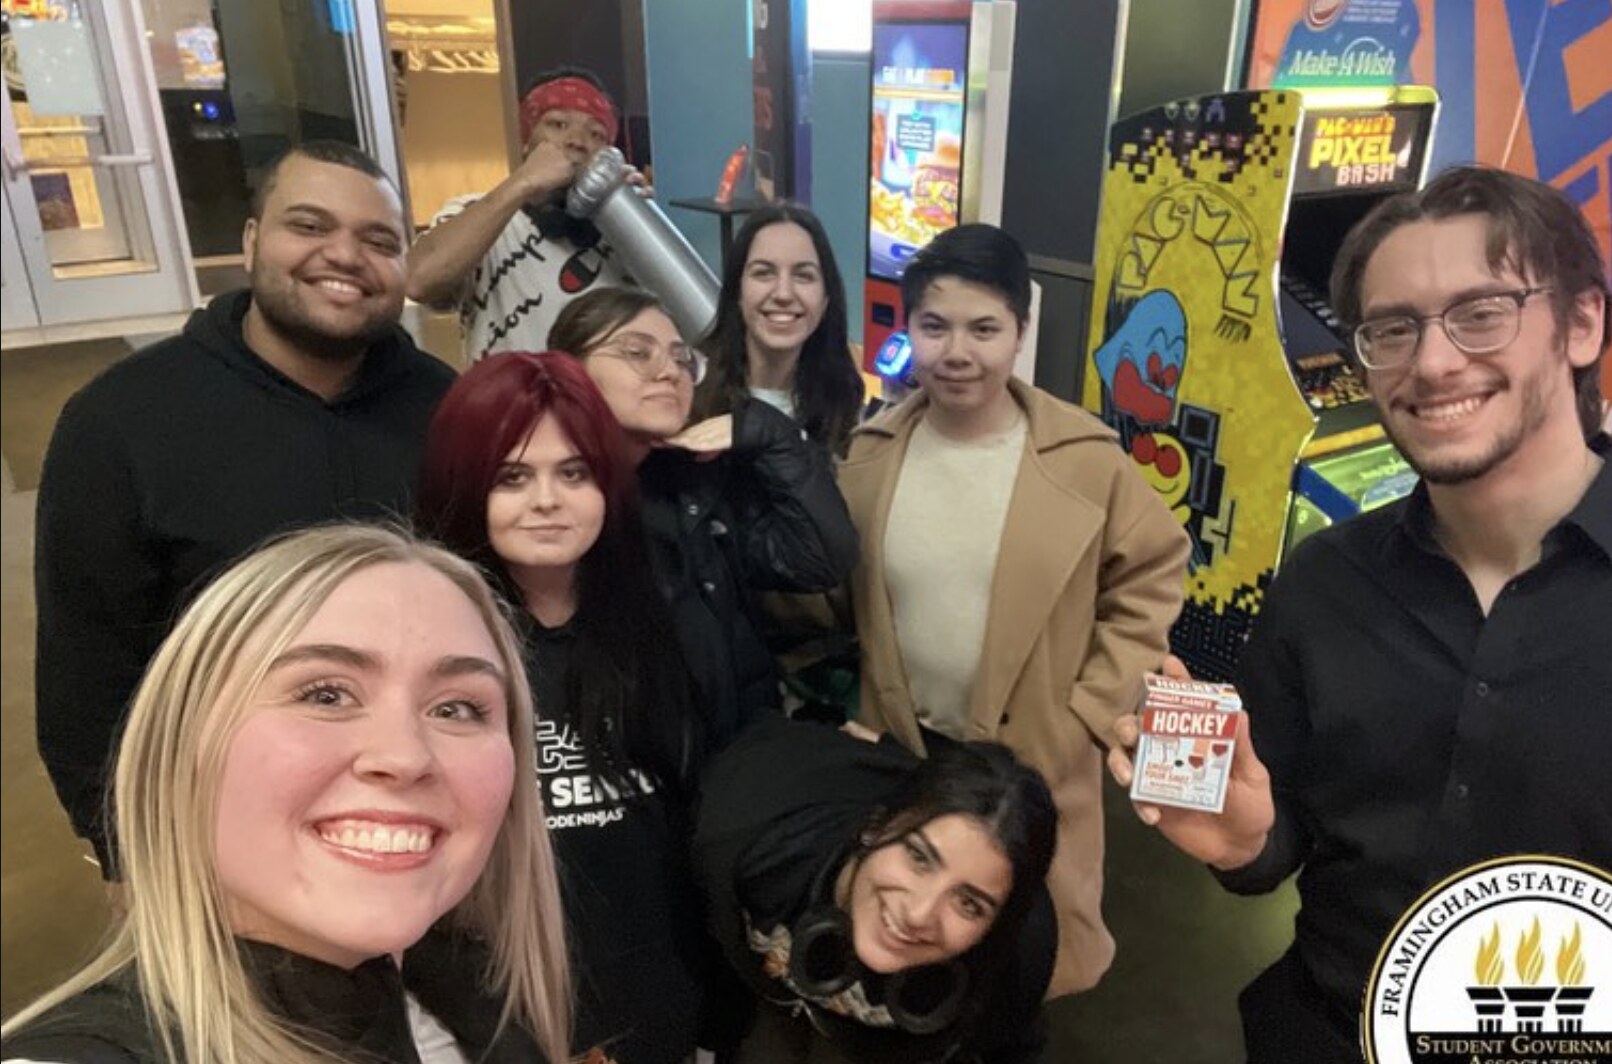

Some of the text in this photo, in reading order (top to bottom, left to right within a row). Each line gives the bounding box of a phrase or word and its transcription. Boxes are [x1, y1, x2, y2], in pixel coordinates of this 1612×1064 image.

[1308, 134, 1397, 169] PIXEL
[1336, 162, 1395, 186] BASH
[1152, 710, 1229, 736] HOCKEY
